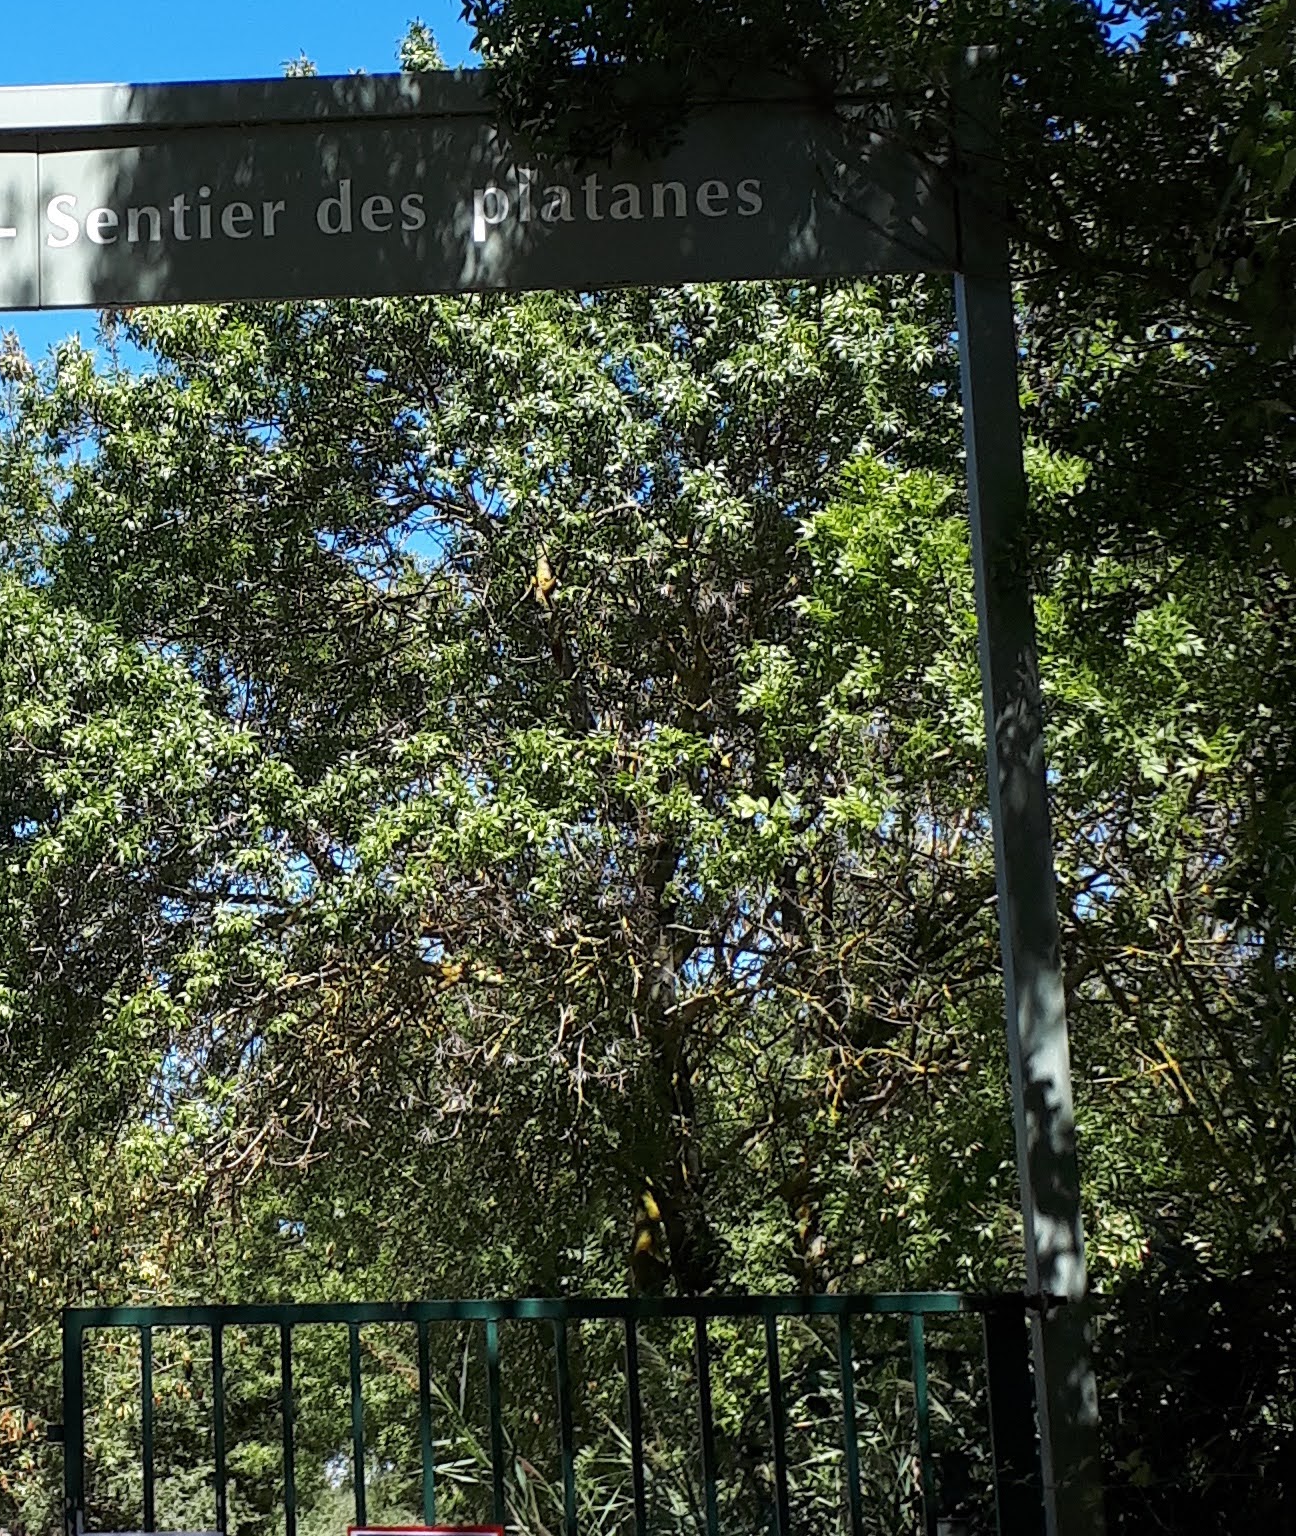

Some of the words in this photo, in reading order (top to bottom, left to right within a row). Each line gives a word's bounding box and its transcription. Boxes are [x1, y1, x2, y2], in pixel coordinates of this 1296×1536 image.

[46, 185, 287, 248] Sentier
[316, 179, 426, 234] des
[472, 168, 764, 242] platanes
